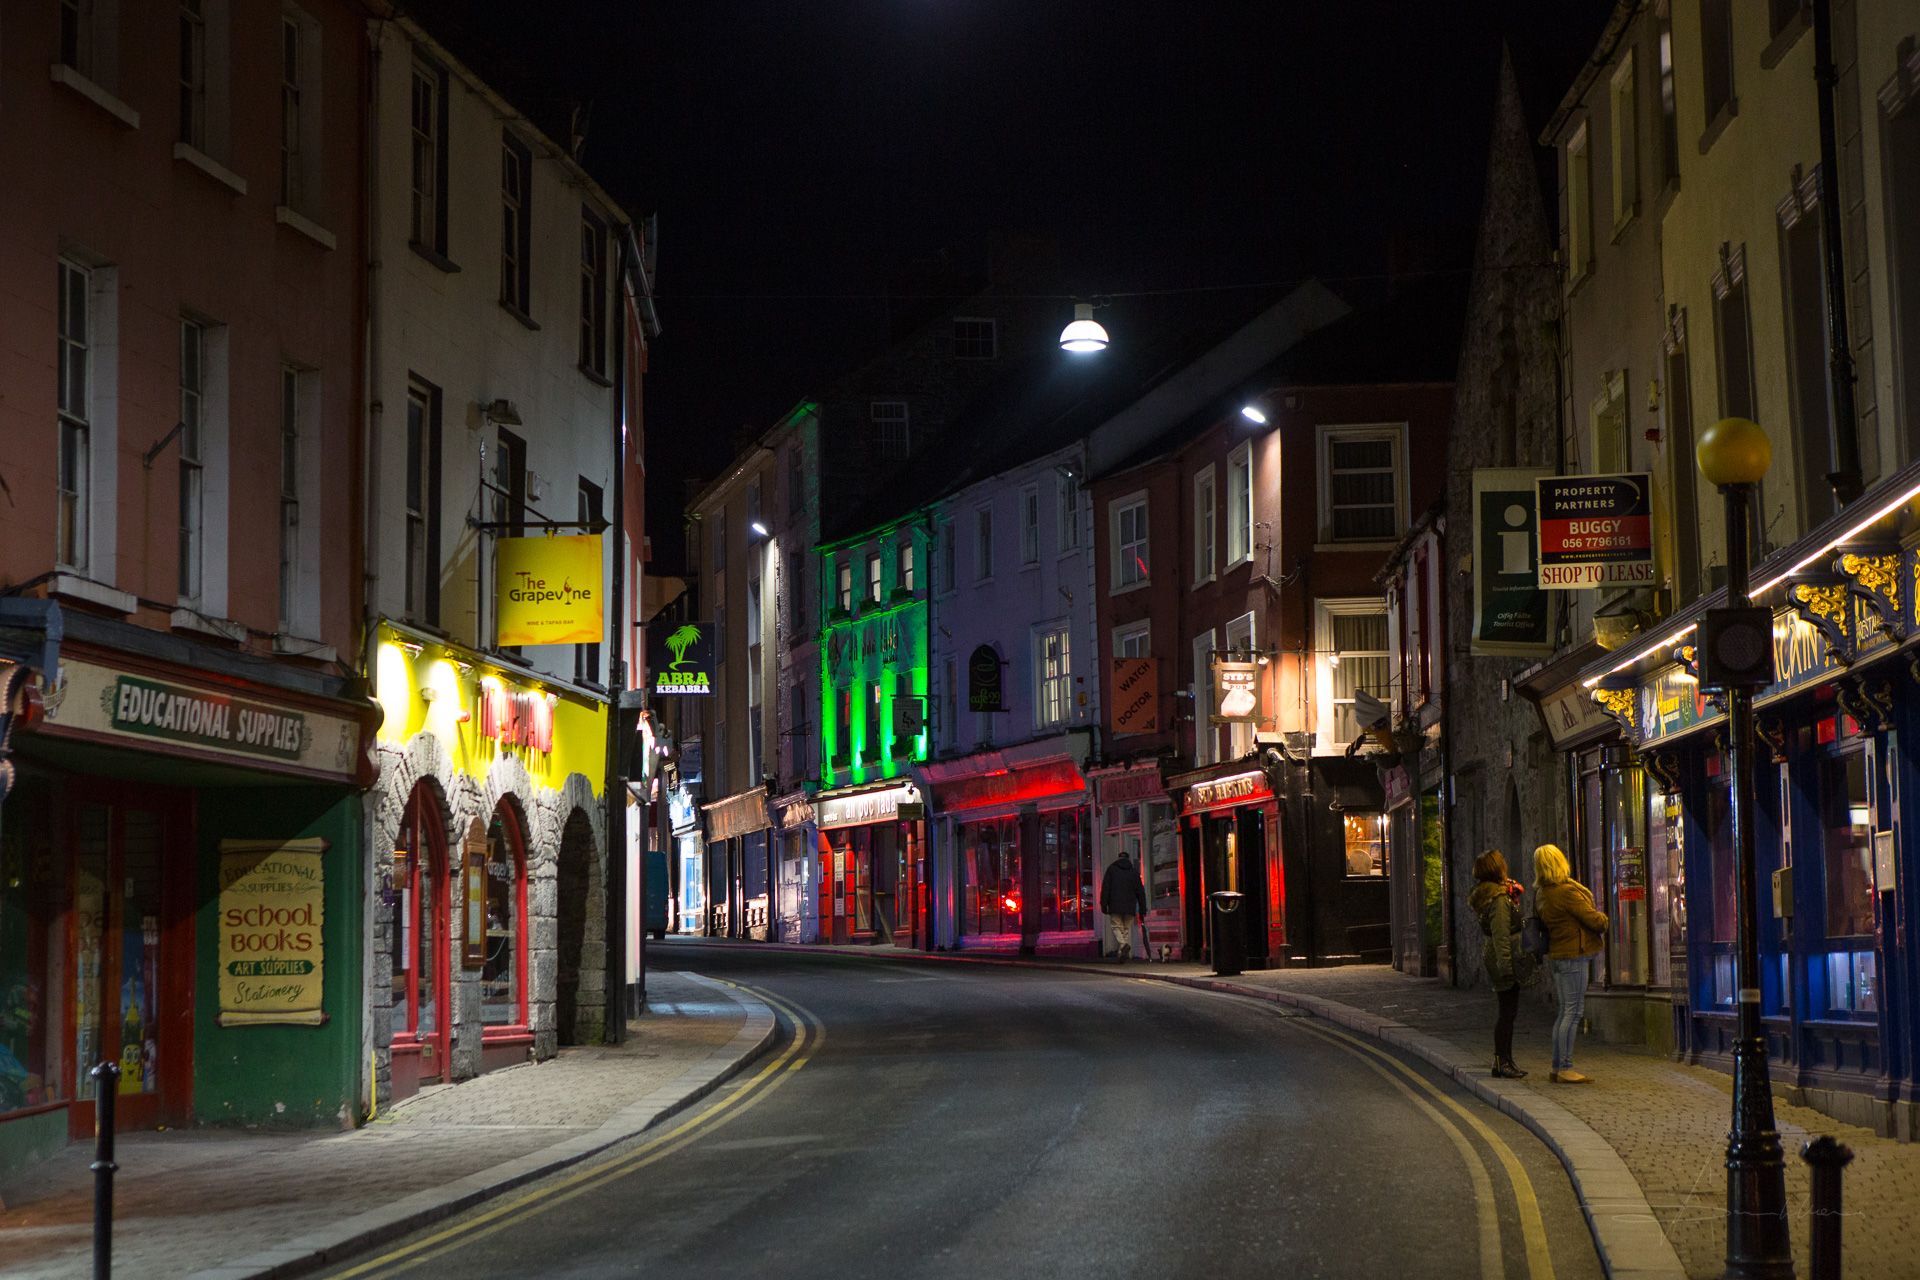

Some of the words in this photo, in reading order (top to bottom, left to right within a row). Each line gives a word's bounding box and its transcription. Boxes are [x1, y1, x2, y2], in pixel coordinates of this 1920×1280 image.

[1555, 486, 1616, 497] PROPERTY
[1555, 499, 1616, 510] PARTNERS
[1569, 519, 1622, 535] BUGGY
[1562, 538, 1583, 549] 056
[1585, 536, 1632, 547] 7796161
[515, 572, 546, 590] The
[1543, 566, 1582, 585] SHOP
[1585, 565, 1605, 583] TO
[1608, 564, 1654, 582] LEASE
[656, 671, 710, 685] ABRA
[1119, 661, 1150, 692] WATCH
[1223, 672, 1254, 682] SYD'S
[656, 685, 710, 694] KEBABRA
[1118, 691, 1152, 725] DOCTOR
[117, 683, 231, 740] EDUCATIONAL
[236, 708, 302, 752] SUPPLIES
[224, 862, 318, 883] EDUCATIONAL
[247, 882, 294, 893] SUPPLIES
[235, 961, 255, 976] ART
[261, 959, 305, 975] SUPPLIES
[234, 981, 304, 1005] Stationery
